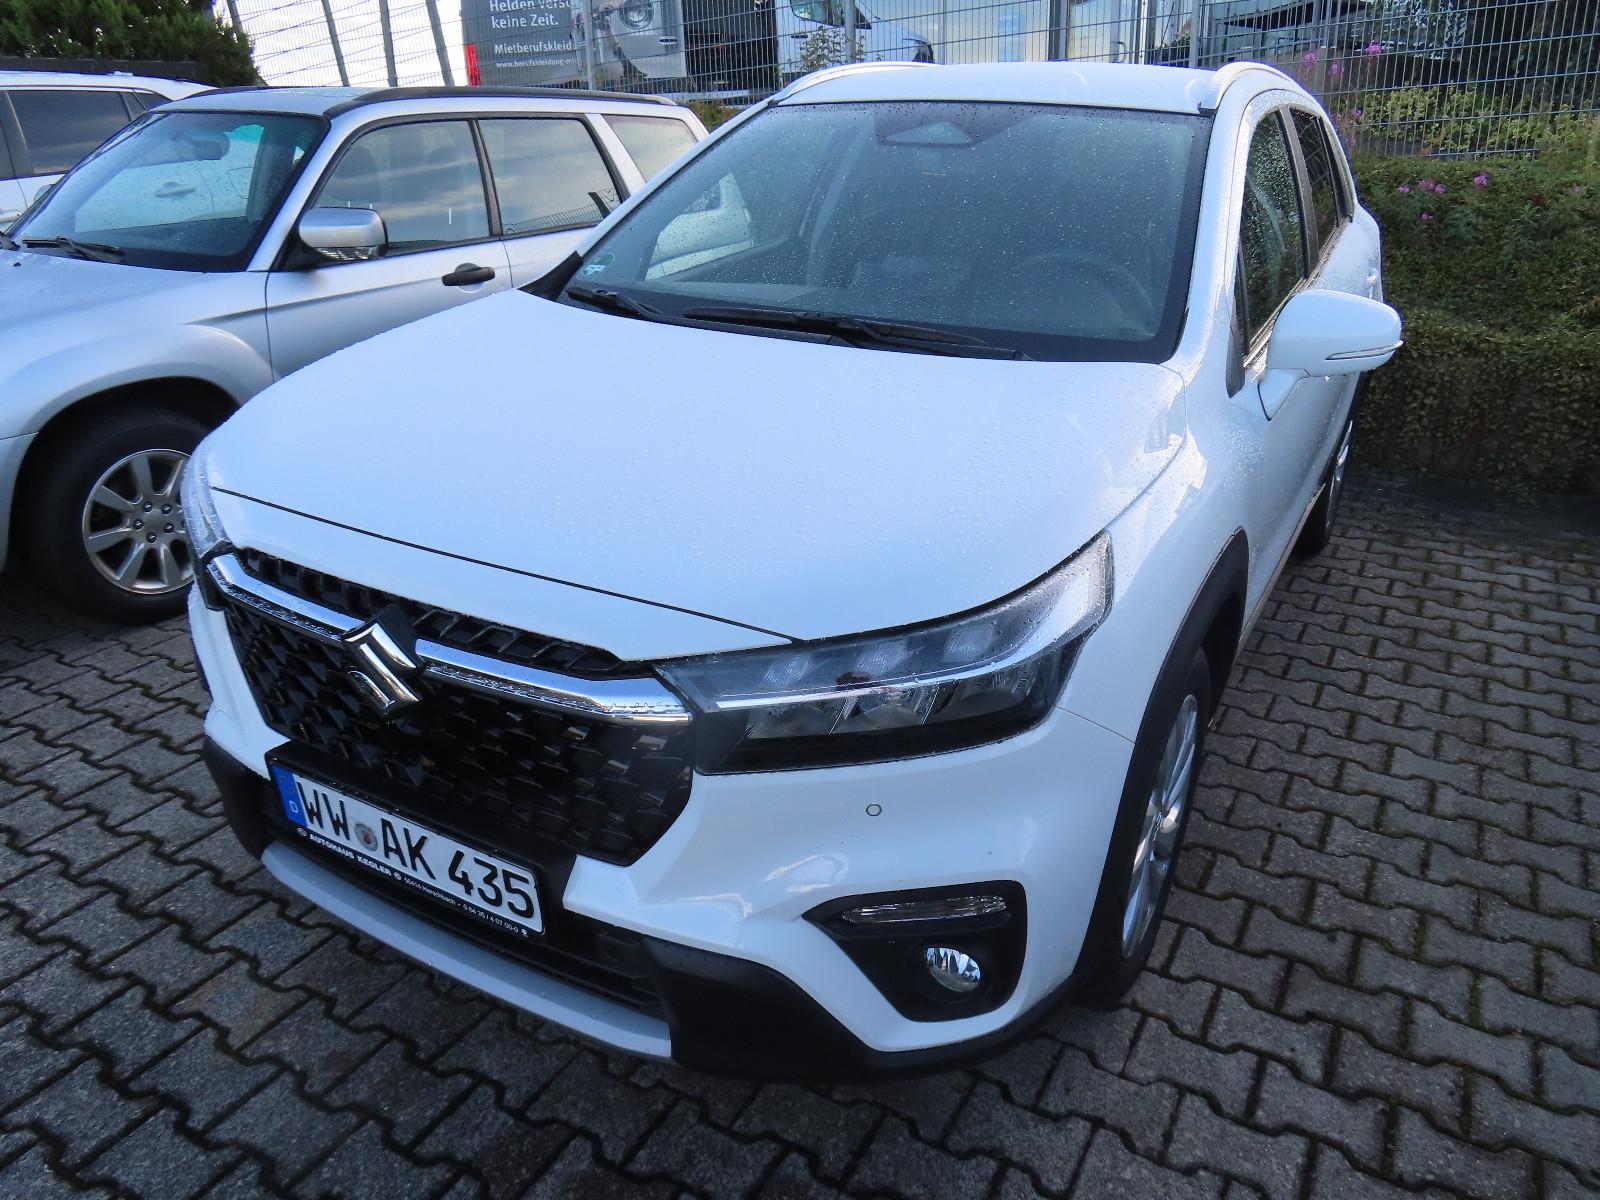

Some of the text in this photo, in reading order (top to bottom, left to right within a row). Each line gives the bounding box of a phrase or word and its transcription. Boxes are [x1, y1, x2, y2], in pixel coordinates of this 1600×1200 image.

[489, 0, 535, 12] Helden
[491, 13, 559, 28] keine Zeit.
[289, 800, 299, 814] D
[296, 781, 535, 919] WW AK 435
[309, 833, 355, 859] AUTOHAUS
